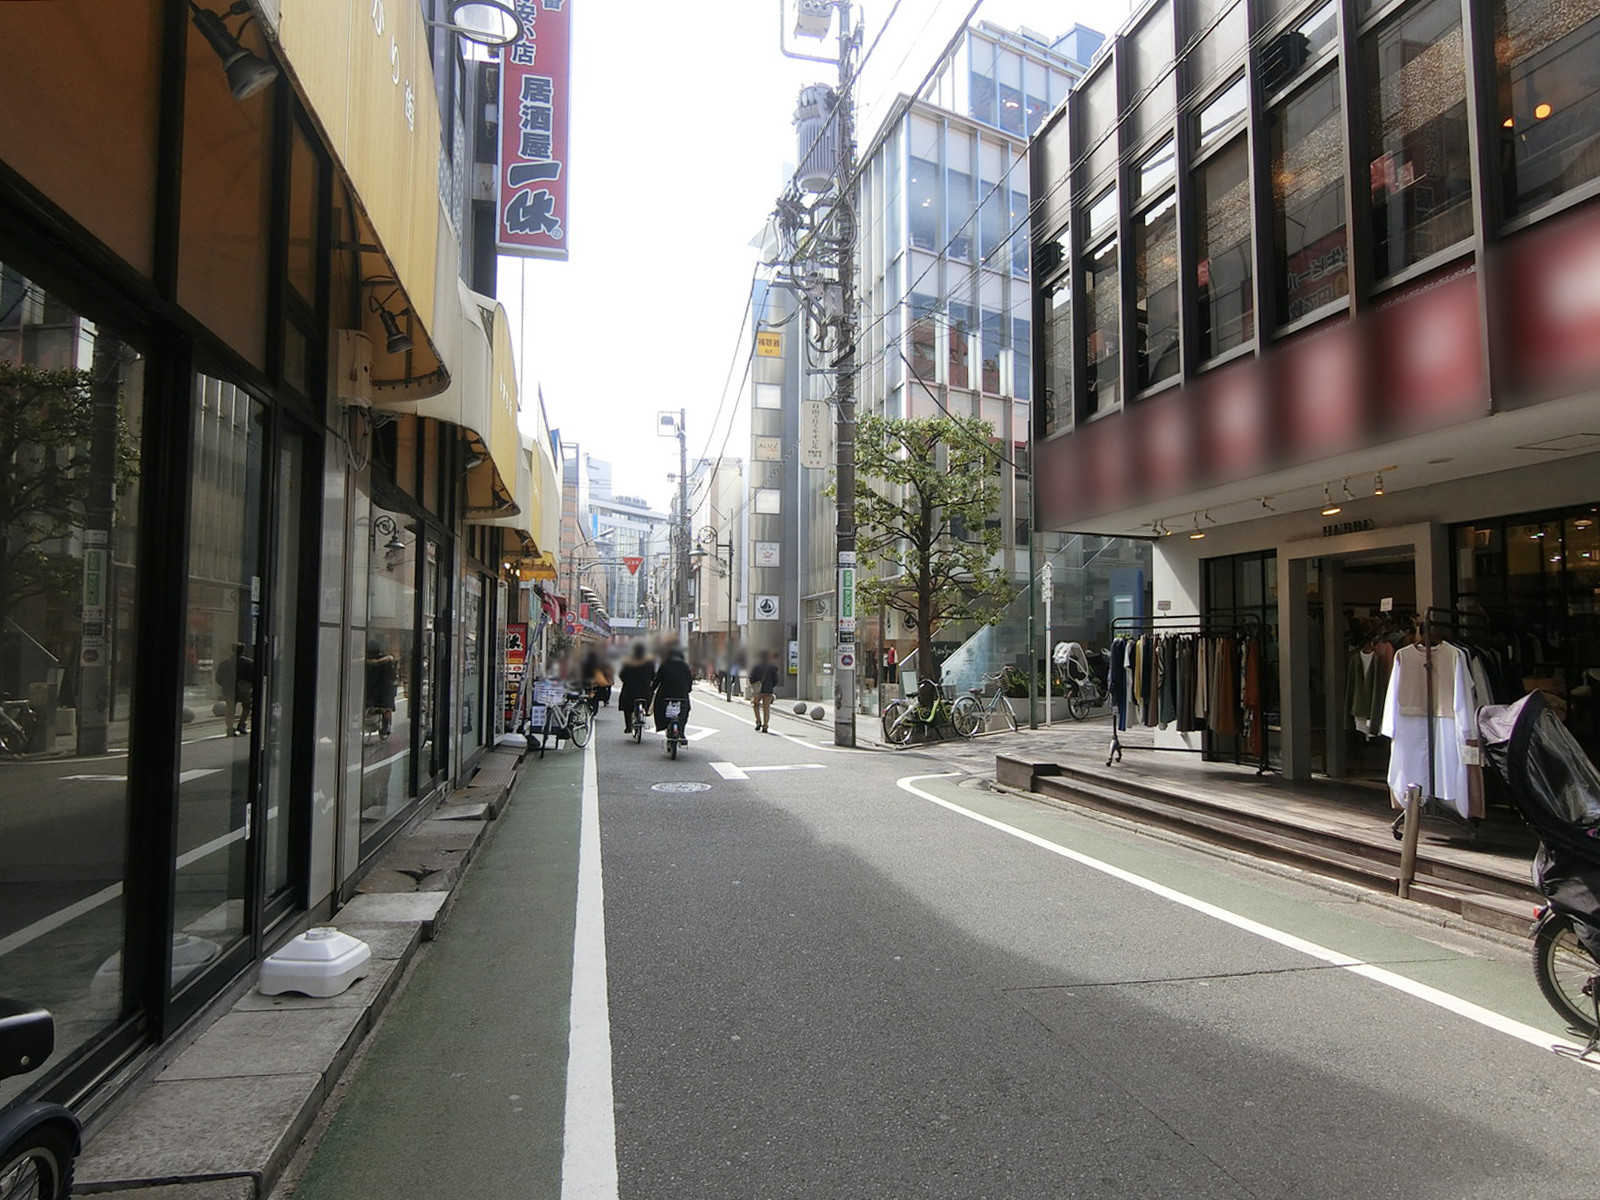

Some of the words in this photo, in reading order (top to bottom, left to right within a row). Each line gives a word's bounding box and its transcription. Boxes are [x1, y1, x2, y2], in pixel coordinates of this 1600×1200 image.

[519, 74, 554, 160] 居酒屋
[504, 160, 562, 235] 一休
